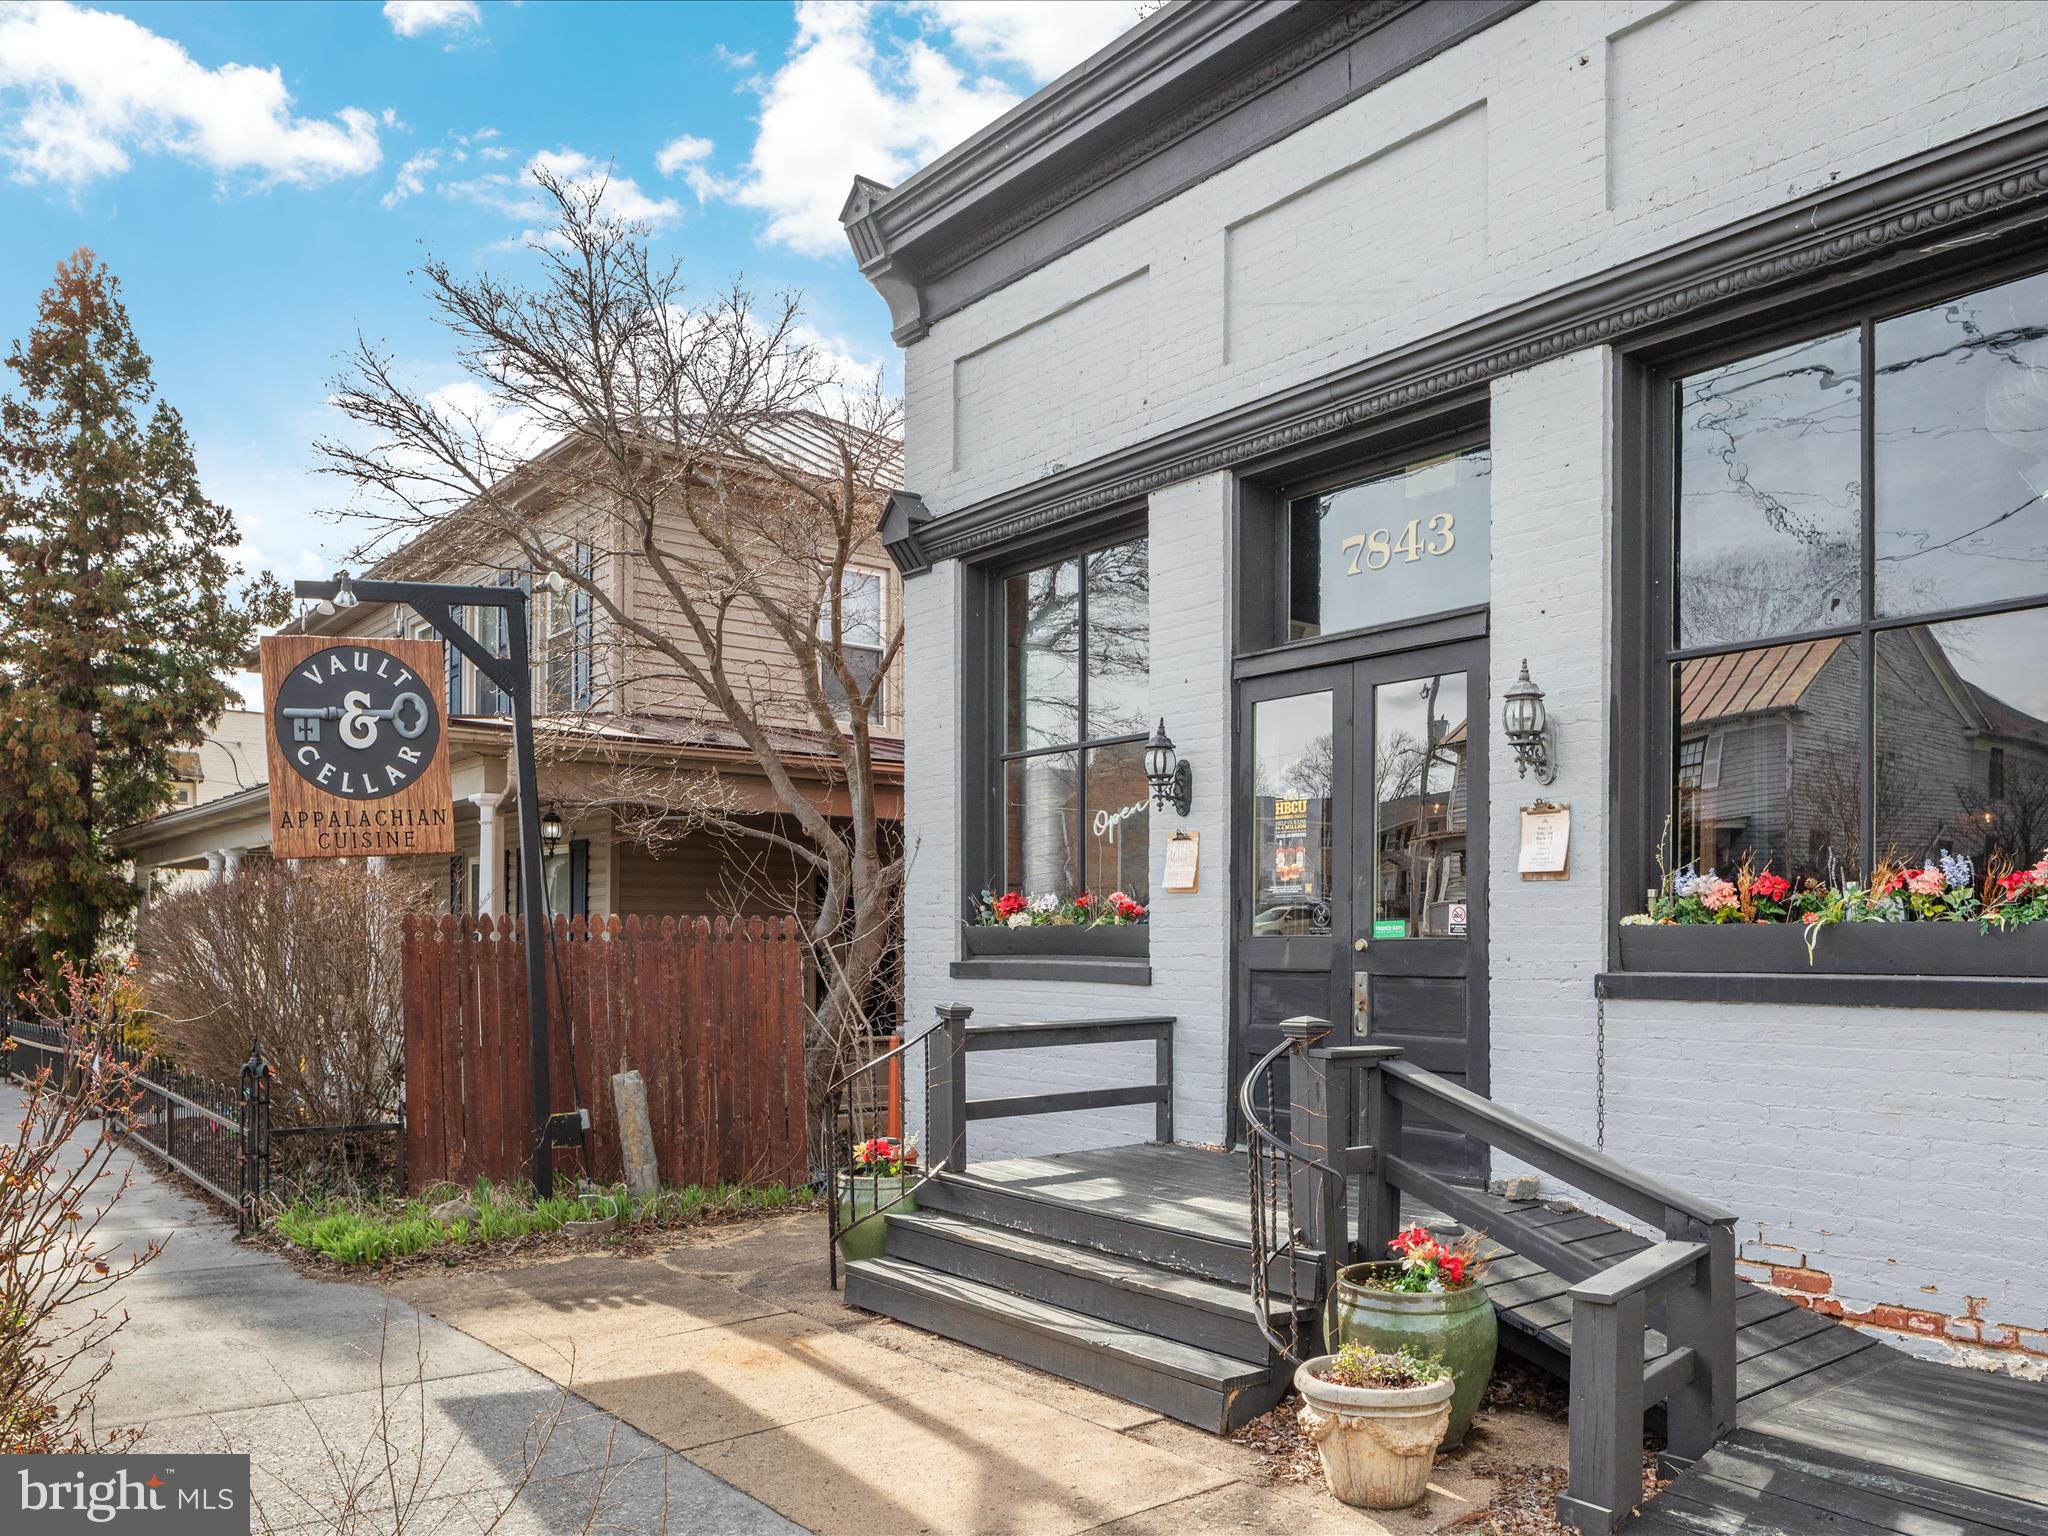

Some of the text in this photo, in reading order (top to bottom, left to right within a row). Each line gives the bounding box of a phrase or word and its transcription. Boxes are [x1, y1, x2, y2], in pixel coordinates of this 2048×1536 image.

[1342, 512, 1456, 577] 7843
[302, 651, 413, 688] VAULT
[339, 690, 380, 749] &
[297, 745, 421, 794] CELLAR
[280, 808, 447, 829] APPALACHIAN
[1093, 799, 1149, 844] Open
[1275, 800, 1307, 815] HBCU
[318, 831, 416, 850] CUISINE
